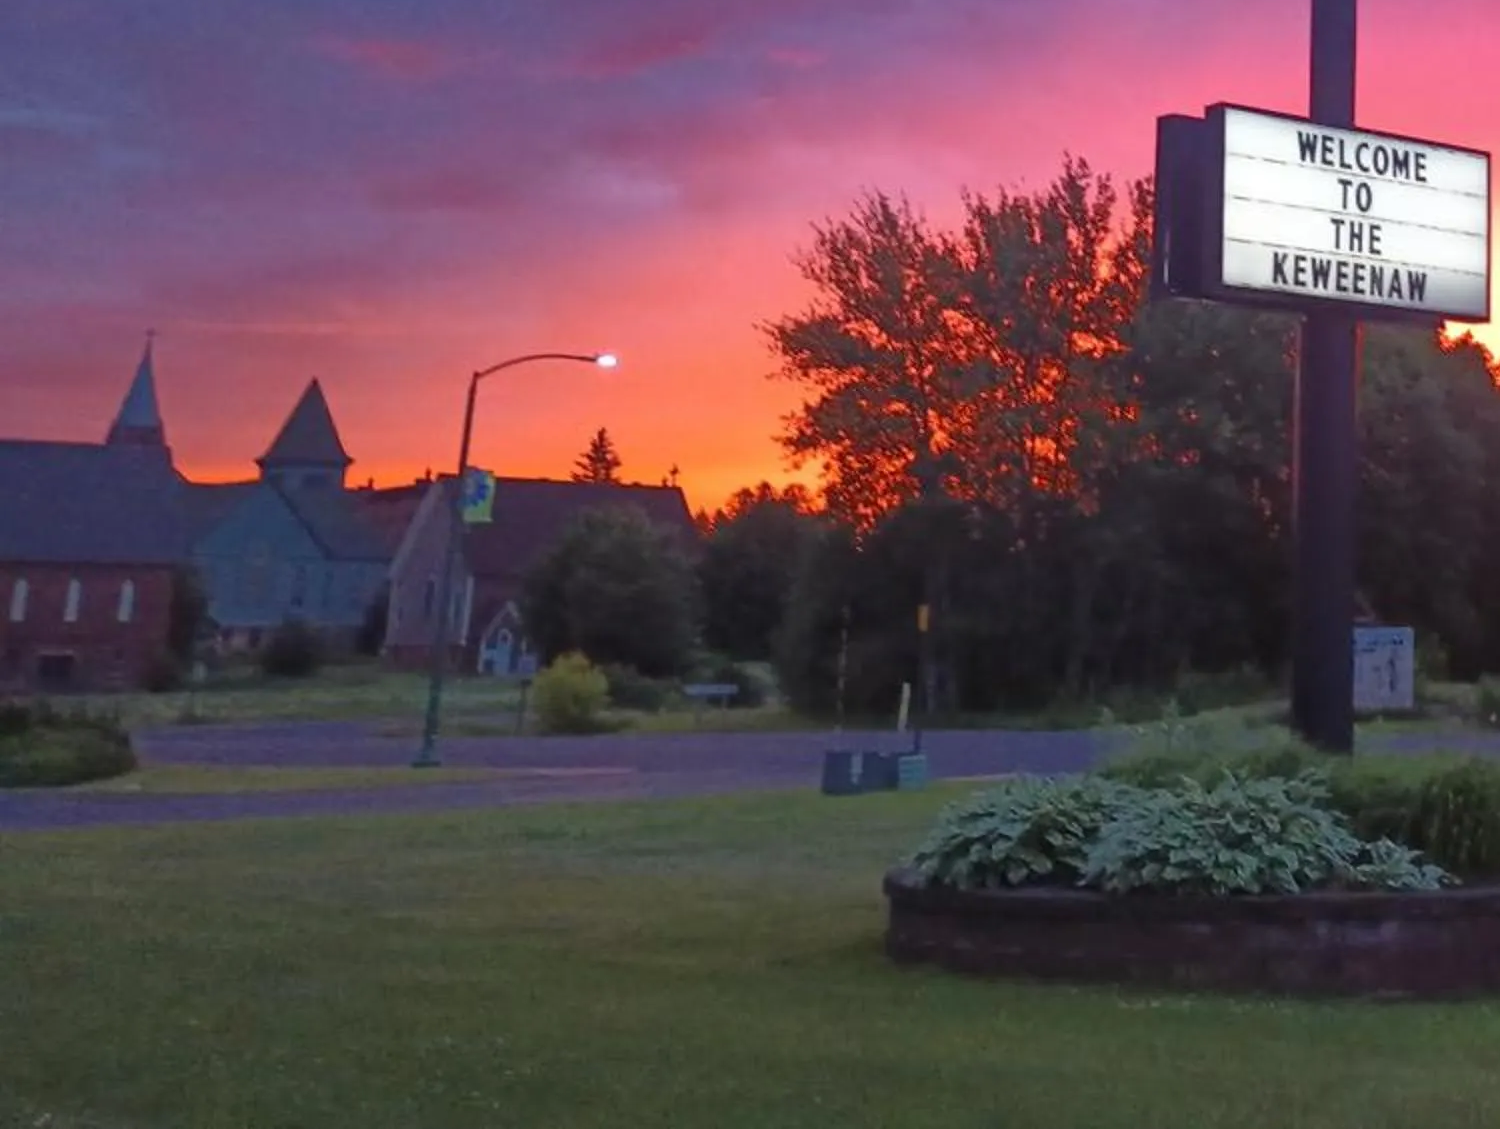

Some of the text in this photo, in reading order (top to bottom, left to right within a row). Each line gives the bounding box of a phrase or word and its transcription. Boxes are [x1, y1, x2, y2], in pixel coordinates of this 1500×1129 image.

[1297, 130, 1427, 182] WELCOME
[1338, 178, 1372, 212] TO
[1331, 218, 1382, 255] THE
[1272, 251, 1427, 301] KEWEENAW
